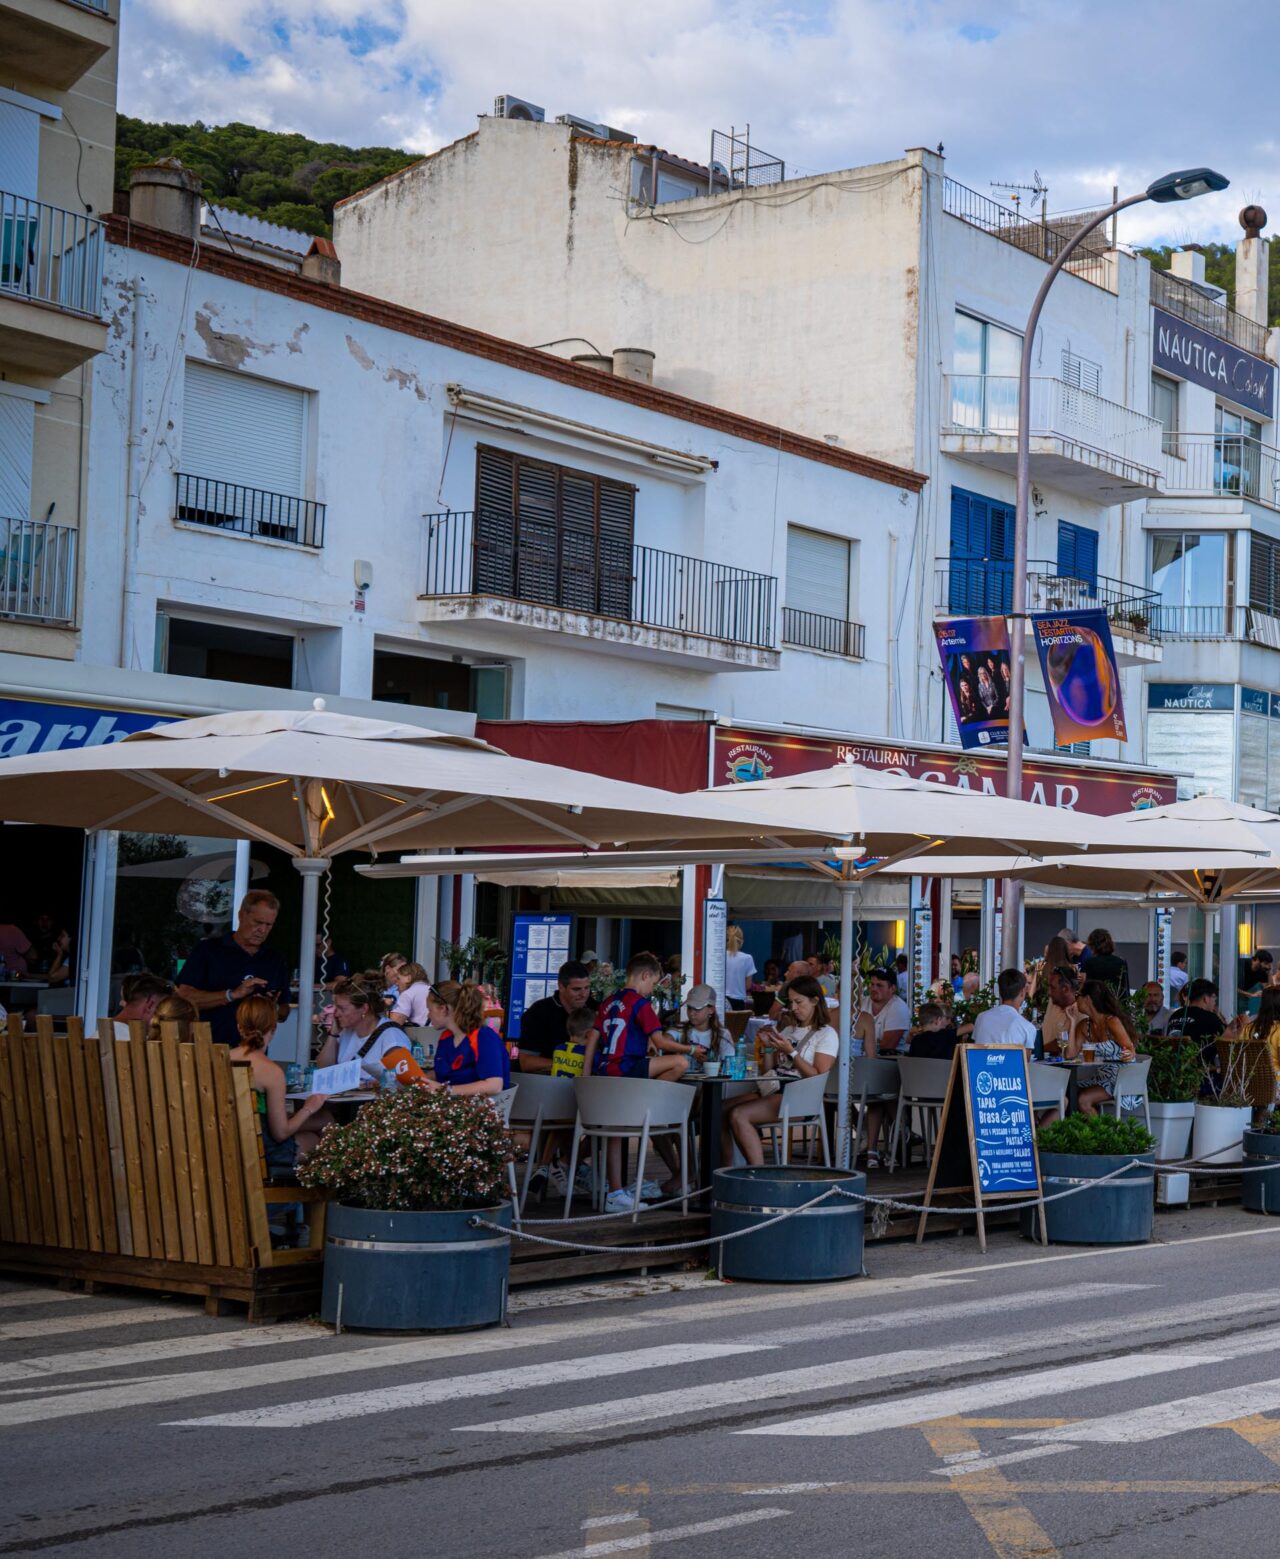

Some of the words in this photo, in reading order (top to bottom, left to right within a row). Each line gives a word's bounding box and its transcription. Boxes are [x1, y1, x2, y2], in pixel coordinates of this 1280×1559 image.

[1052, 619, 1070, 628] JAZZ
[941, 637, 966, 647] Artemis
[1041, 634, 1083, 646] HORITZONS
[728, 744, 772, 762] RESTAURANT
[837, 745, 917, 767] RESTAURANT
[1132, 787, 1163, 801] RESTAURANT
[992, 1077, 1022, 1091] PAELLAS
[977, 1097, 997, 1109] TAPAS
[979, 1110, 1000, 1124] Brasa
[1011, 1109, 1026, 1127] grill
